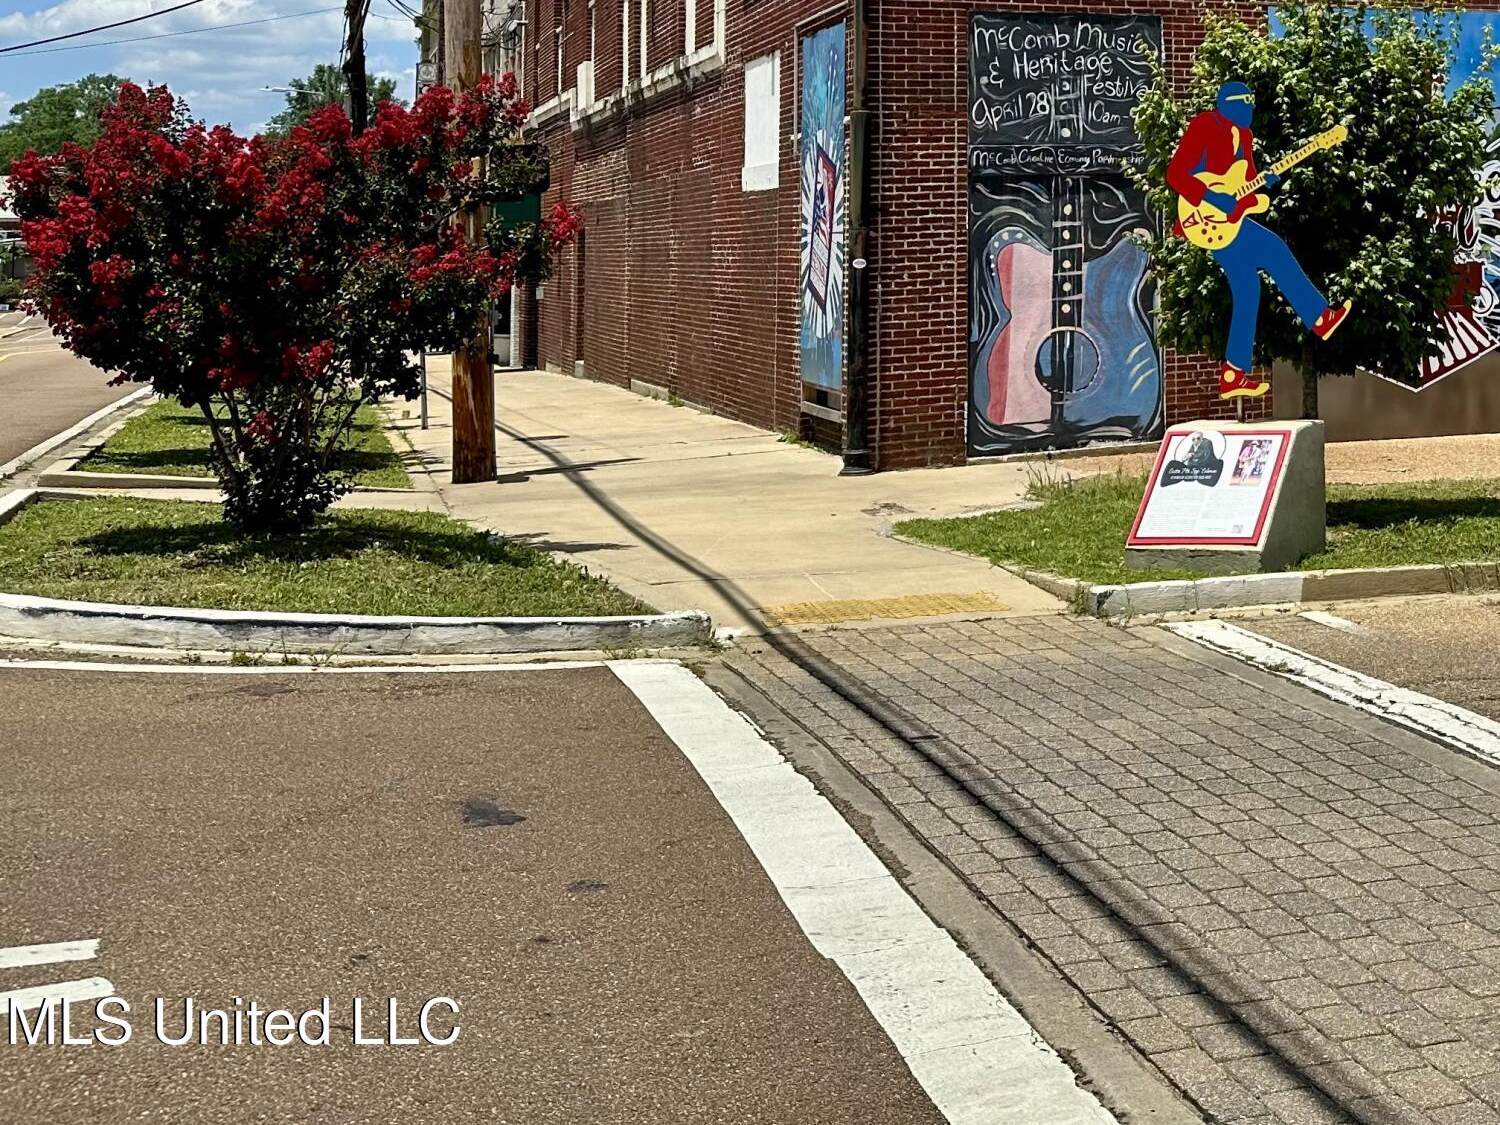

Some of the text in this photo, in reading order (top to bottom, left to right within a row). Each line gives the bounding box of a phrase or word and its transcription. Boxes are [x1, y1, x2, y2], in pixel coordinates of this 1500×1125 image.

[973, 20, 1147, 58] McComb Music
[988, 50, 1113, 89] & Heritage
[972, 91, 1050, 132] April 28
